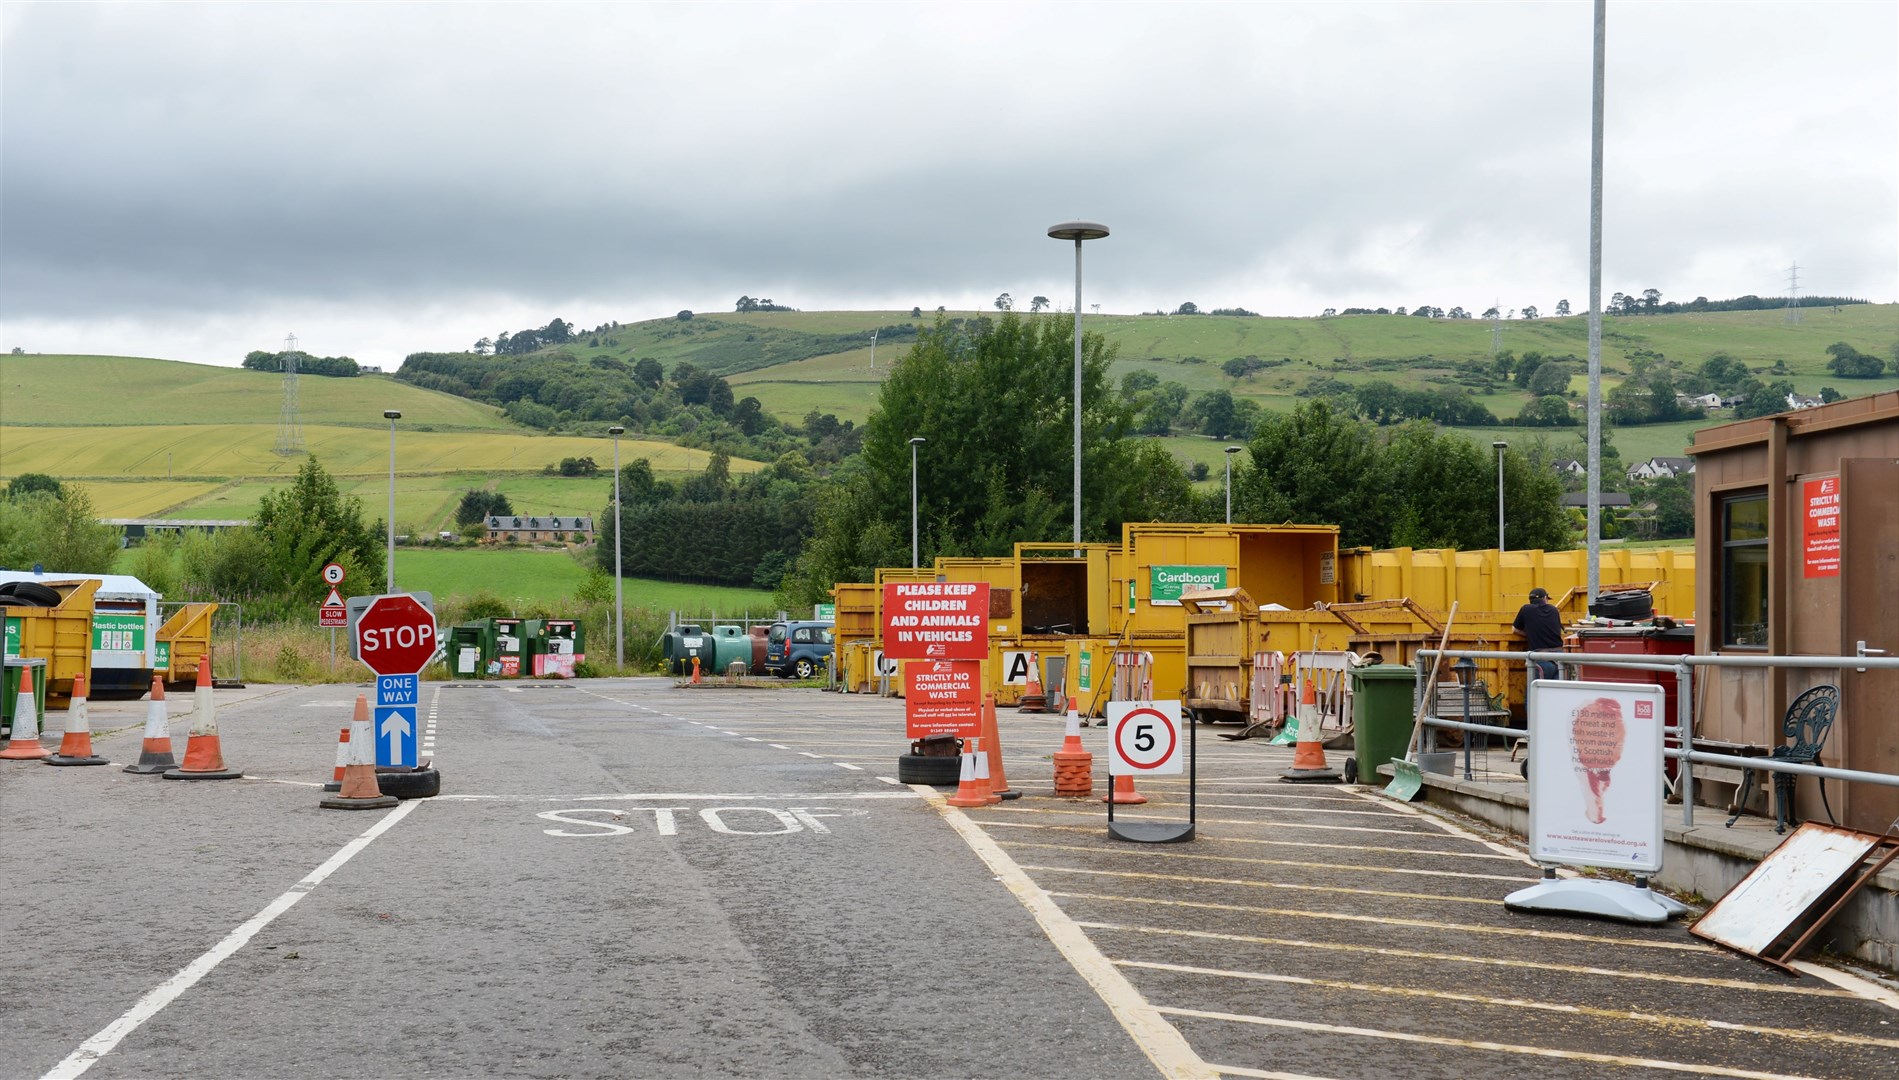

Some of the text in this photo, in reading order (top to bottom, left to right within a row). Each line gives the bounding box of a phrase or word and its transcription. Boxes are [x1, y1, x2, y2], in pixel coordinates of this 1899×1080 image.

[1810, 496, 1833, 506] STRICTLY
[1818, 518, 1836, 527] WASTE
[330, 570, 338, 580] 5
[1158, 572, 1220, 584] Cardboard
[897, 584, 976, 596] PLEASE KEEP
[904, 600, 966, 610] CHILDREN
[890, 616, 980, 626] AND ANIMALS
[363, 624, 432, 651] STOP
[898, 631, 972, 642] IN VEHICLES
[1008, 653, 1028, 682] A
[916, 672, 969, 681] STRICTLY NO
[383, 678, 412, 689] ONE
[916, 682, 970, 690] COMMERCIAL
[383, 691, 412, 702] WAY
[1591, 711, 1615, 719] million
[1134, 724, 1155, 752] 5
[1598, 740, 1617, 749] away
[1574, 747, 1613, 756] by Scottish
[1572, 756, 1614, 765] households
[1547, 834, 1648, 847] www.wasteawarelovefood.org.uk
